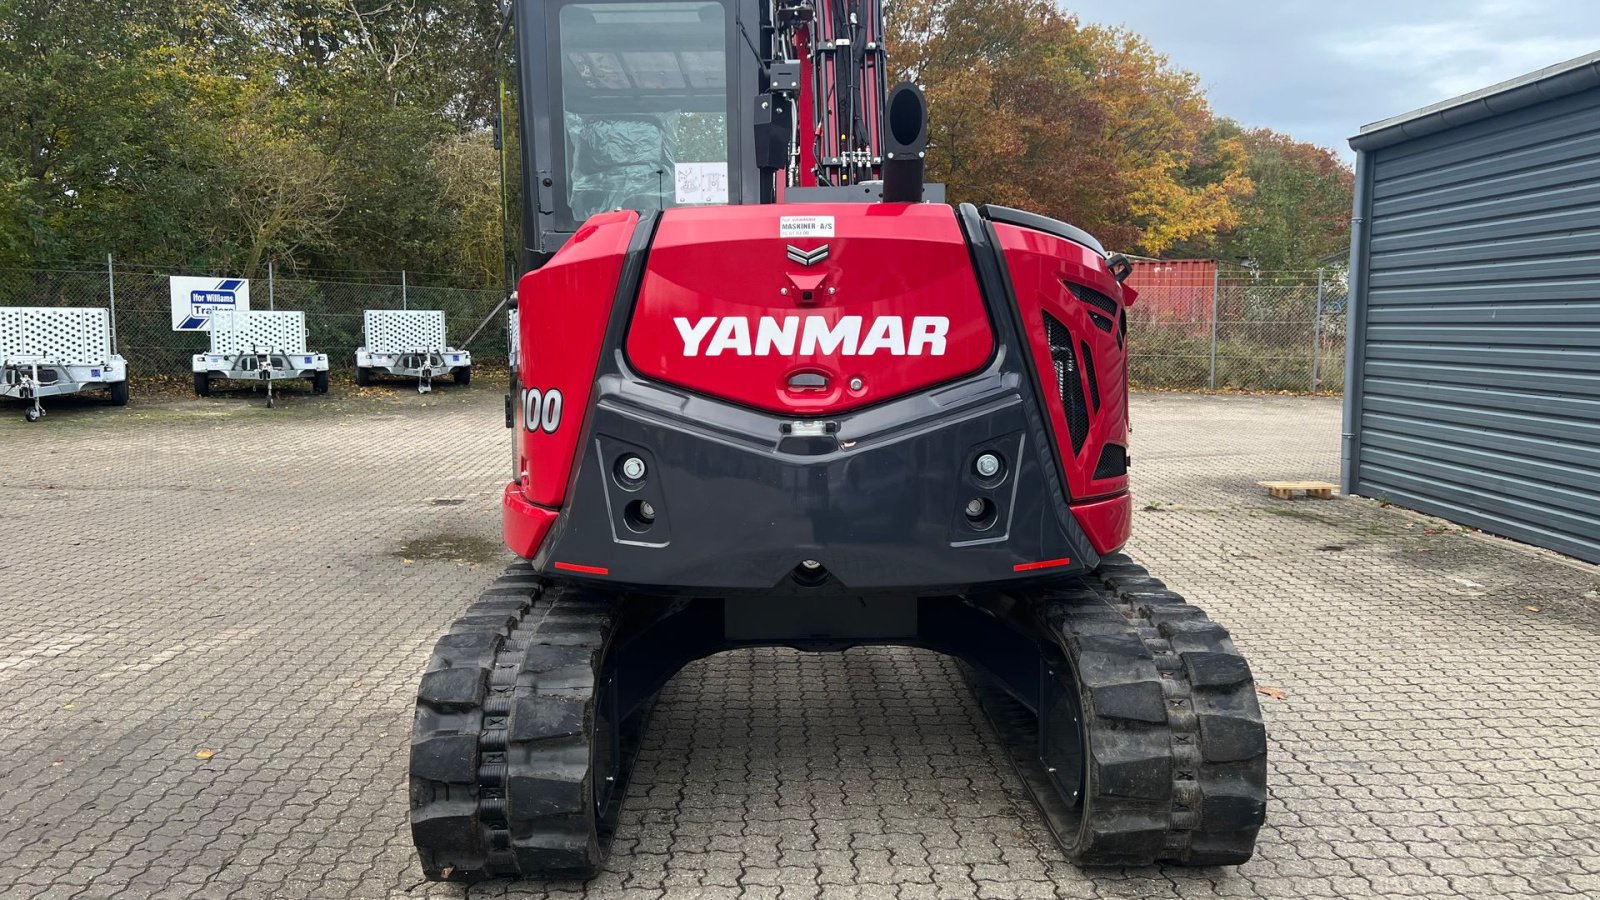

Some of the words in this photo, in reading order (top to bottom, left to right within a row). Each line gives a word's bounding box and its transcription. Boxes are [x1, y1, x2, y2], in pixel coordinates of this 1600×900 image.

[192, 293, 204, 302] Ifor
[206, 293, 234, 303] Williams
[673, 315, 950, 357] YANMAR
[521, 387, 563, 434] 100
